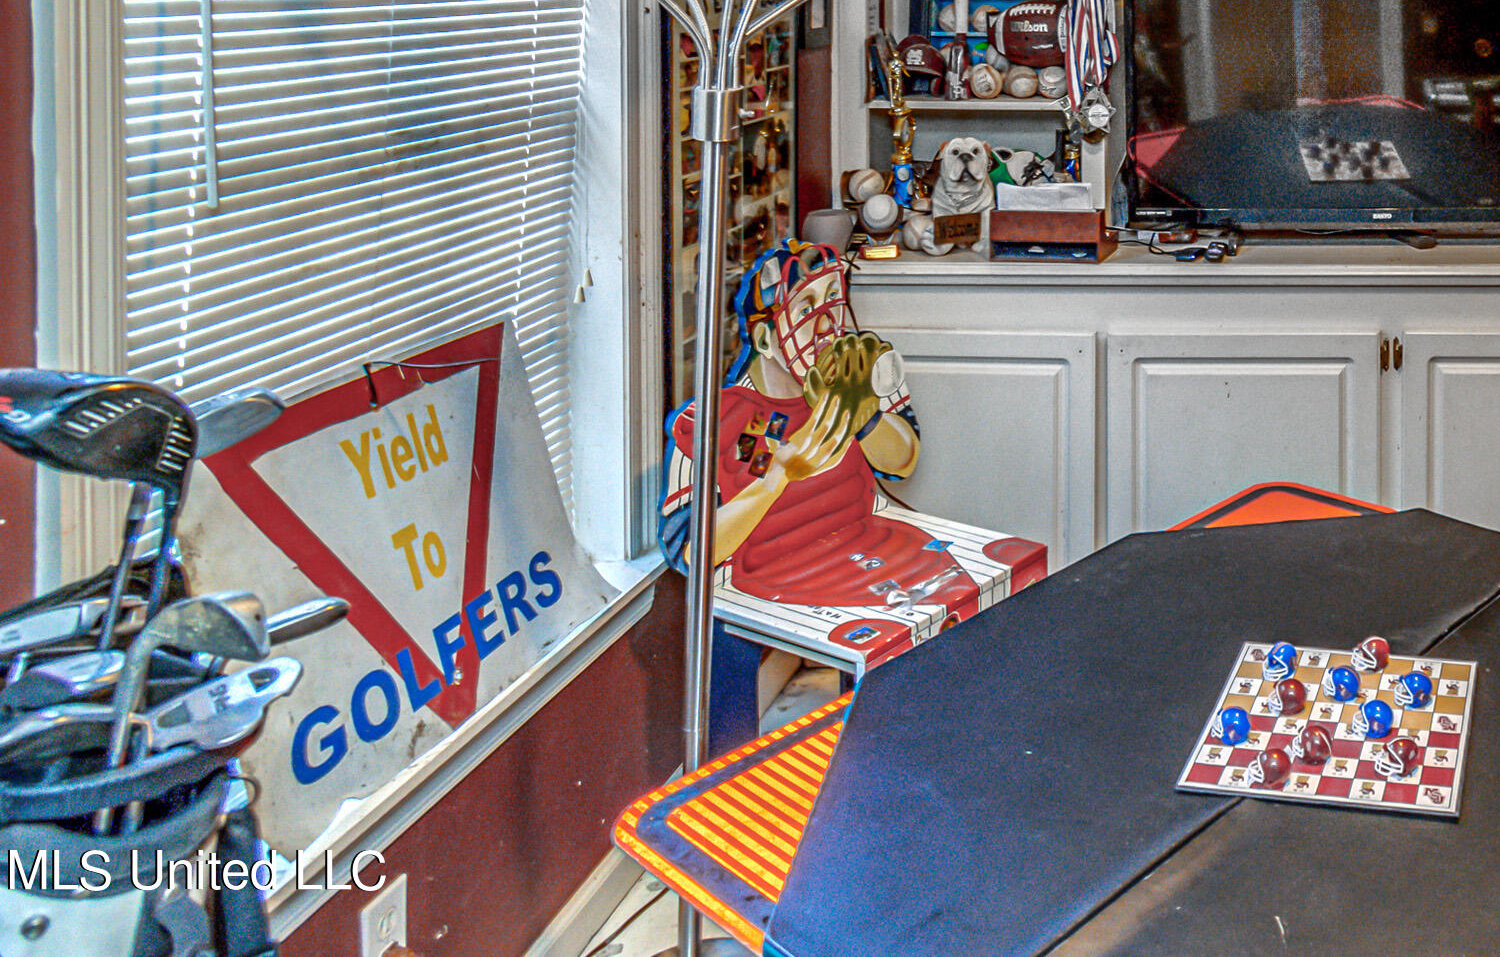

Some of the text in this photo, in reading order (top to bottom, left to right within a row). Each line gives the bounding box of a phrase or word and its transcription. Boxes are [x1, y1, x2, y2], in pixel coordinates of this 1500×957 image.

[339, 403, 450, 499] Yield
[390, 522, 448, 591] To
[290, 550, 564, 786] GOLFERS
